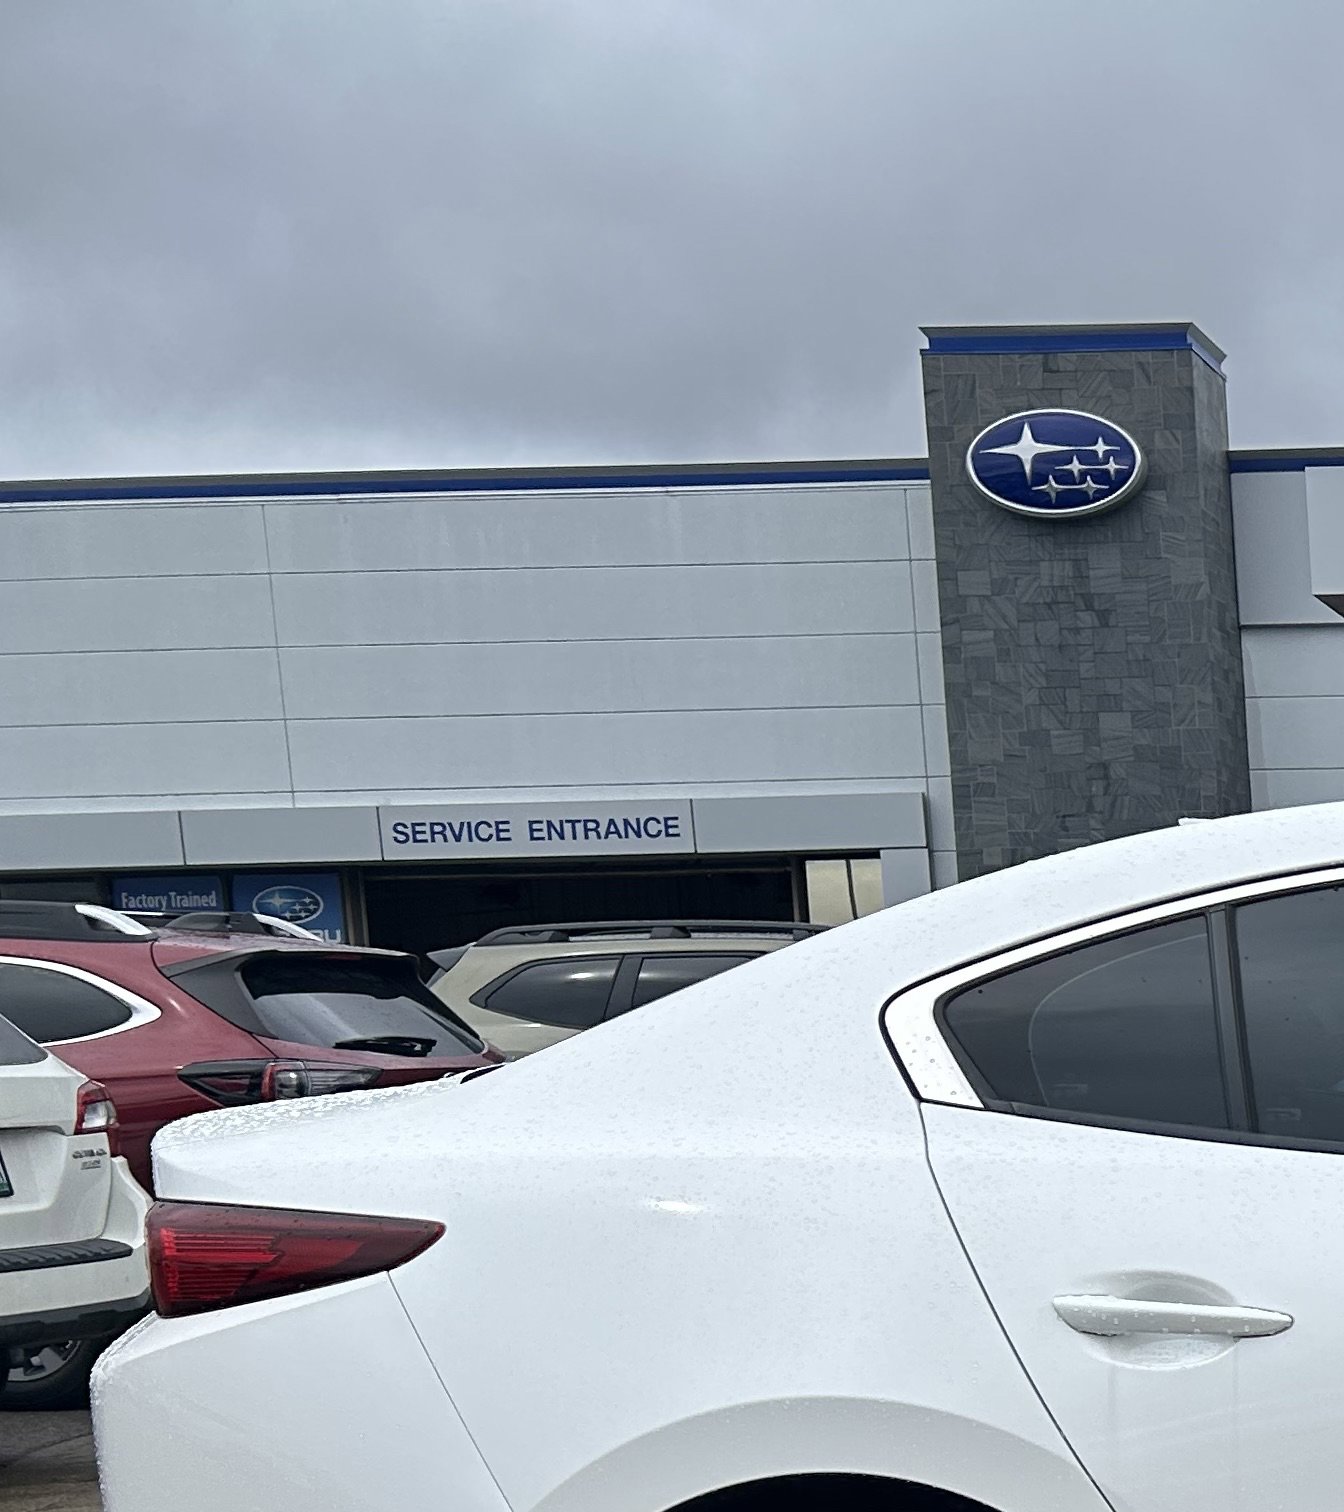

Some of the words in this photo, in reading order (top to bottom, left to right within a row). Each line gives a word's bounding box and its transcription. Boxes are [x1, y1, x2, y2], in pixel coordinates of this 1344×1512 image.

[392, 820, 512, 845] SERVICE
[527, 816, 681, 842] ENTRANCE
[121, 892, 168, 912] Factory
[168, 890, 217, 908] Trained
